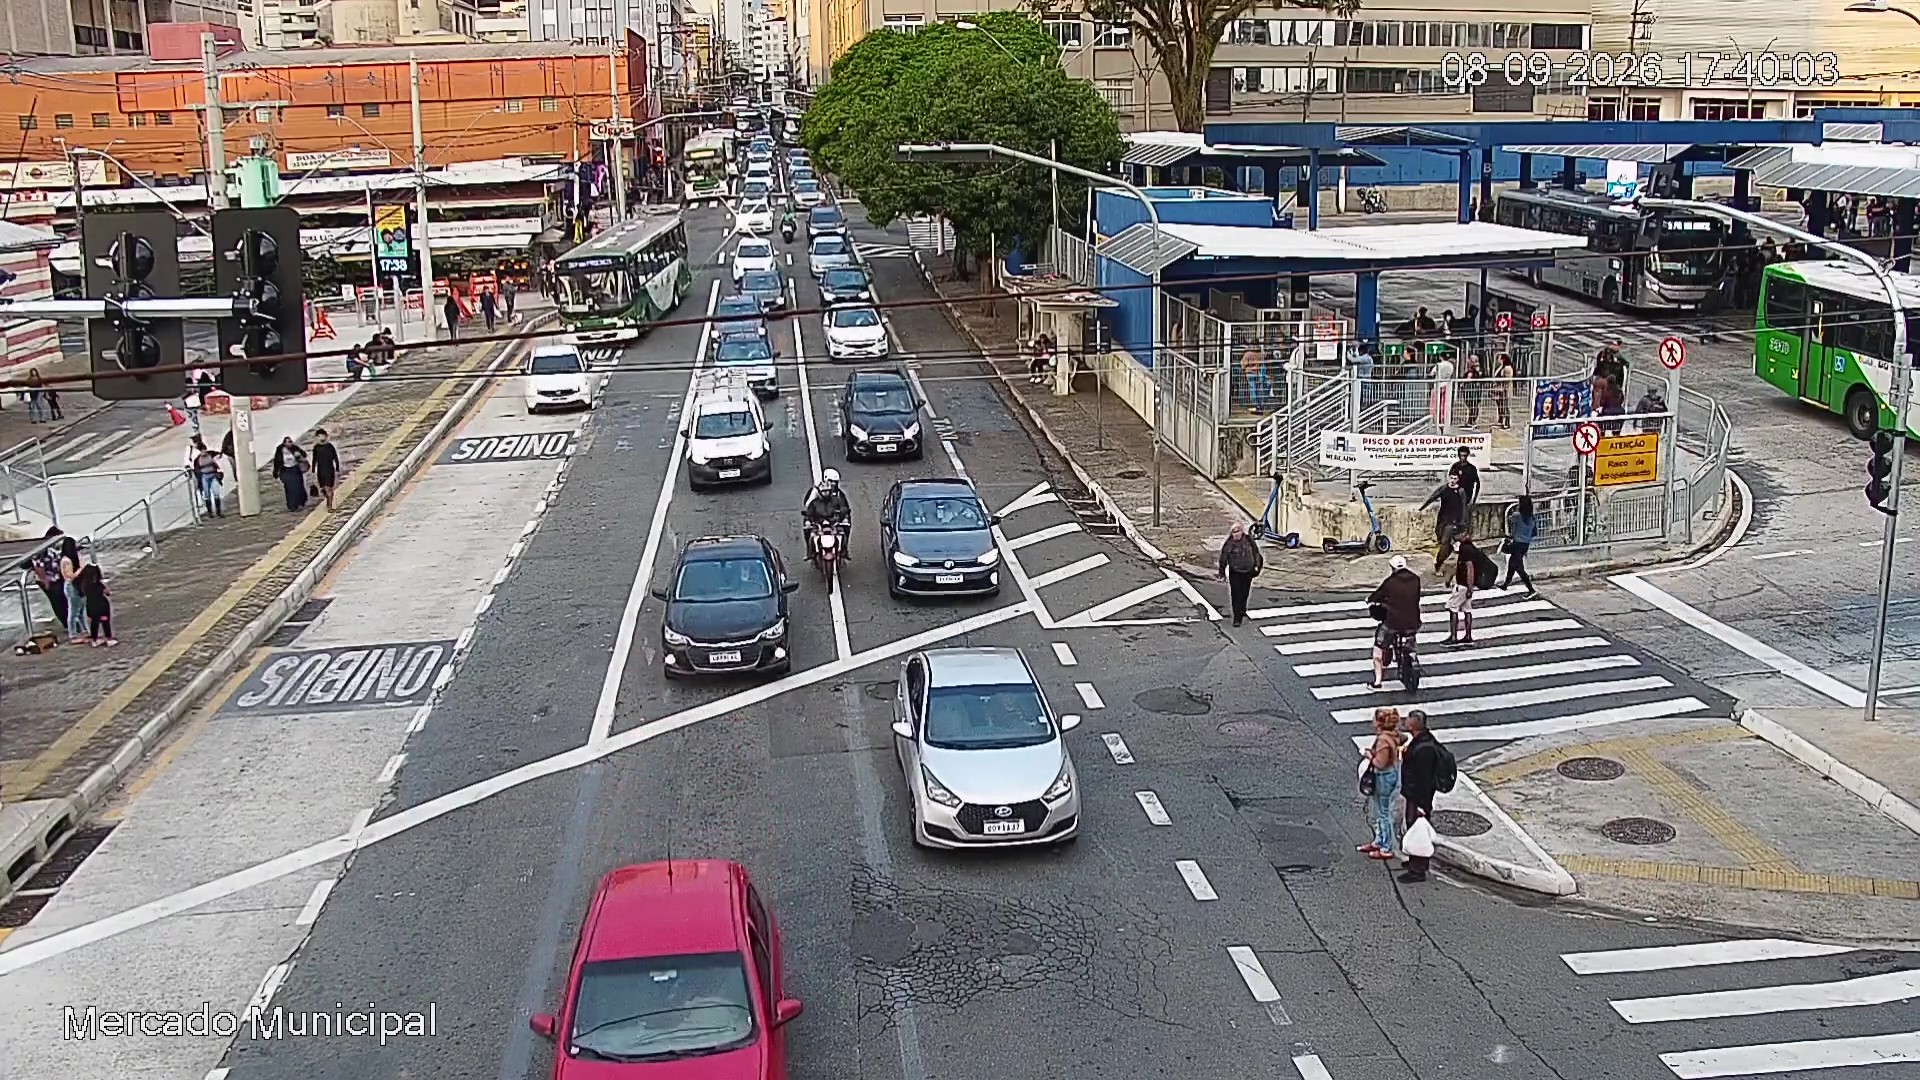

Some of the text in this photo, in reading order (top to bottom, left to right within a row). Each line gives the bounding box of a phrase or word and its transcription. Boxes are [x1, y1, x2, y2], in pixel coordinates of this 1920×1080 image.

[379, 258, 408, 271] 17:38
[1362, 437, 1390, 445] RISCO
[1408, 436, 1484, 445] ATROPELAMENTO
[1609, 439, 1646, 450] ATENÇÃO
